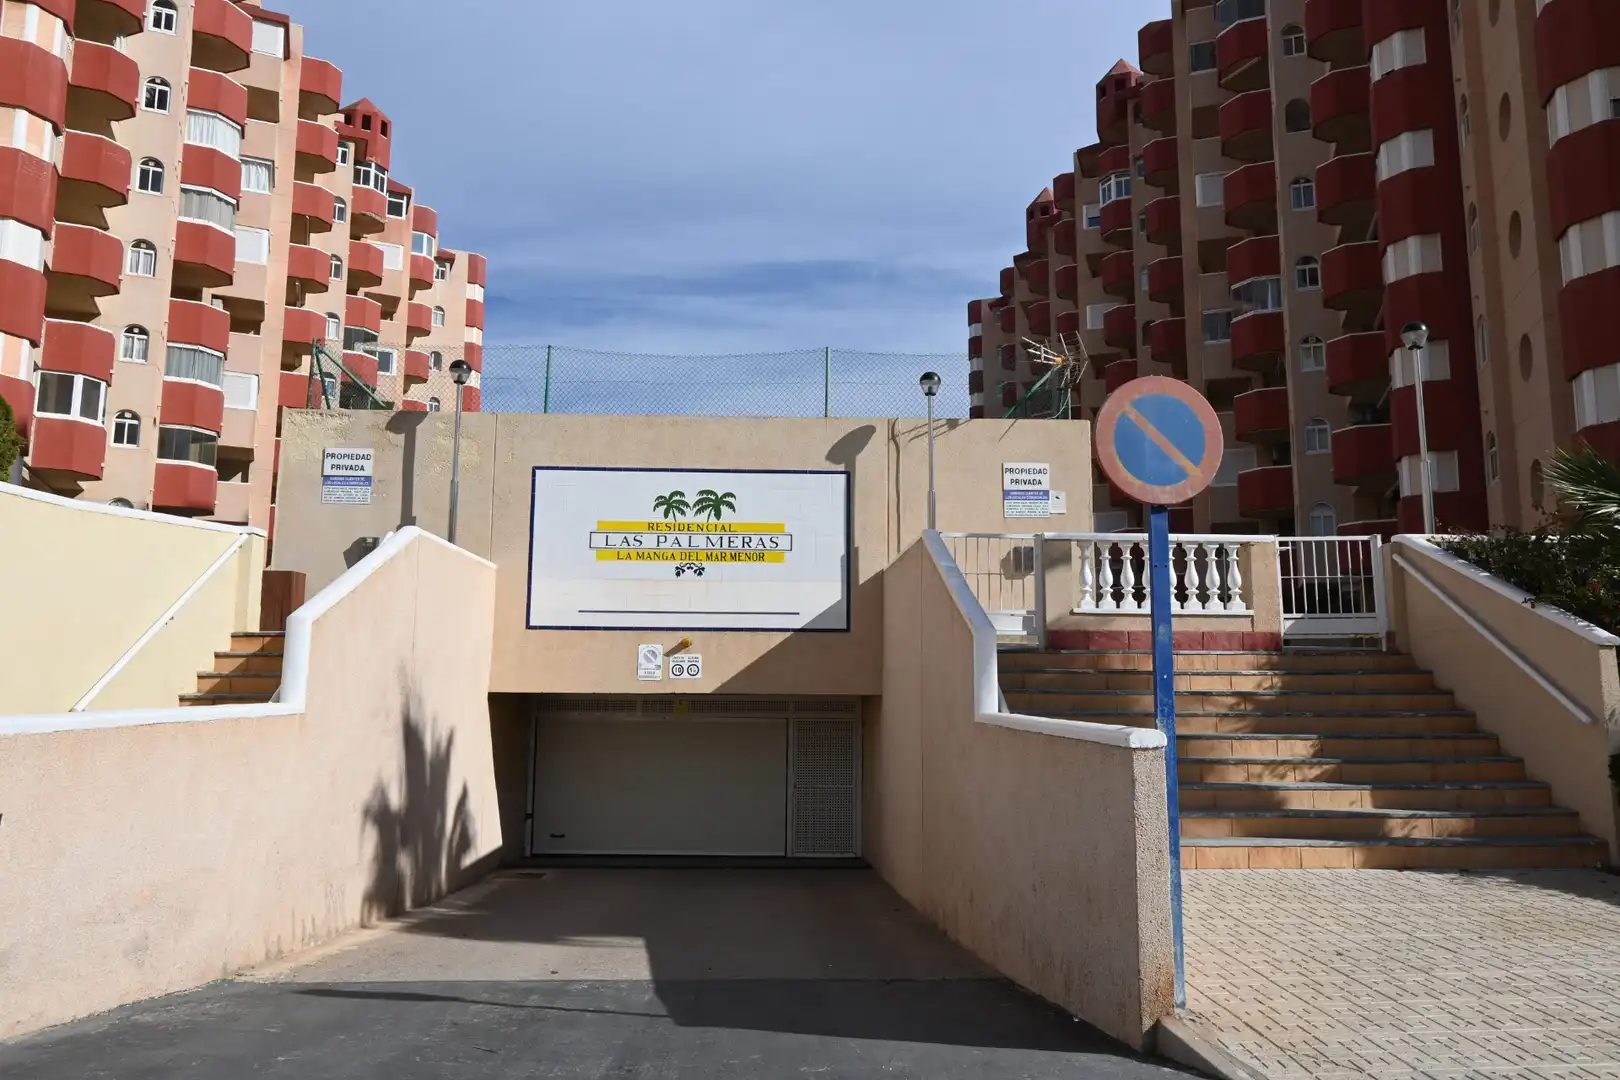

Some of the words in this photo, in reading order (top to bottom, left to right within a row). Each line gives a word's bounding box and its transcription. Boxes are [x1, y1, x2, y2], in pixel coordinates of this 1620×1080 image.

[326, 452, 372, 461] PROPIEDAD
[330, 463, 365, 472] PRIVADA
[1004, 467, 1048, 475] PROPIEDAD
[1010, 478, 1043, 486] PRIVADA
[647, 522, 738, 533] RESIDENCIAL
[605, 534, 643, 547] LAS
[656, 534, 780, 549] PALMERAS
[617, 552, 632, 561] LA
[636, 552, 676, 562] MANGA
[680, 552, 701, 562] DEL
[705, 552, 729, 562] MAR
[730, 552, 765, 562] MENOR
